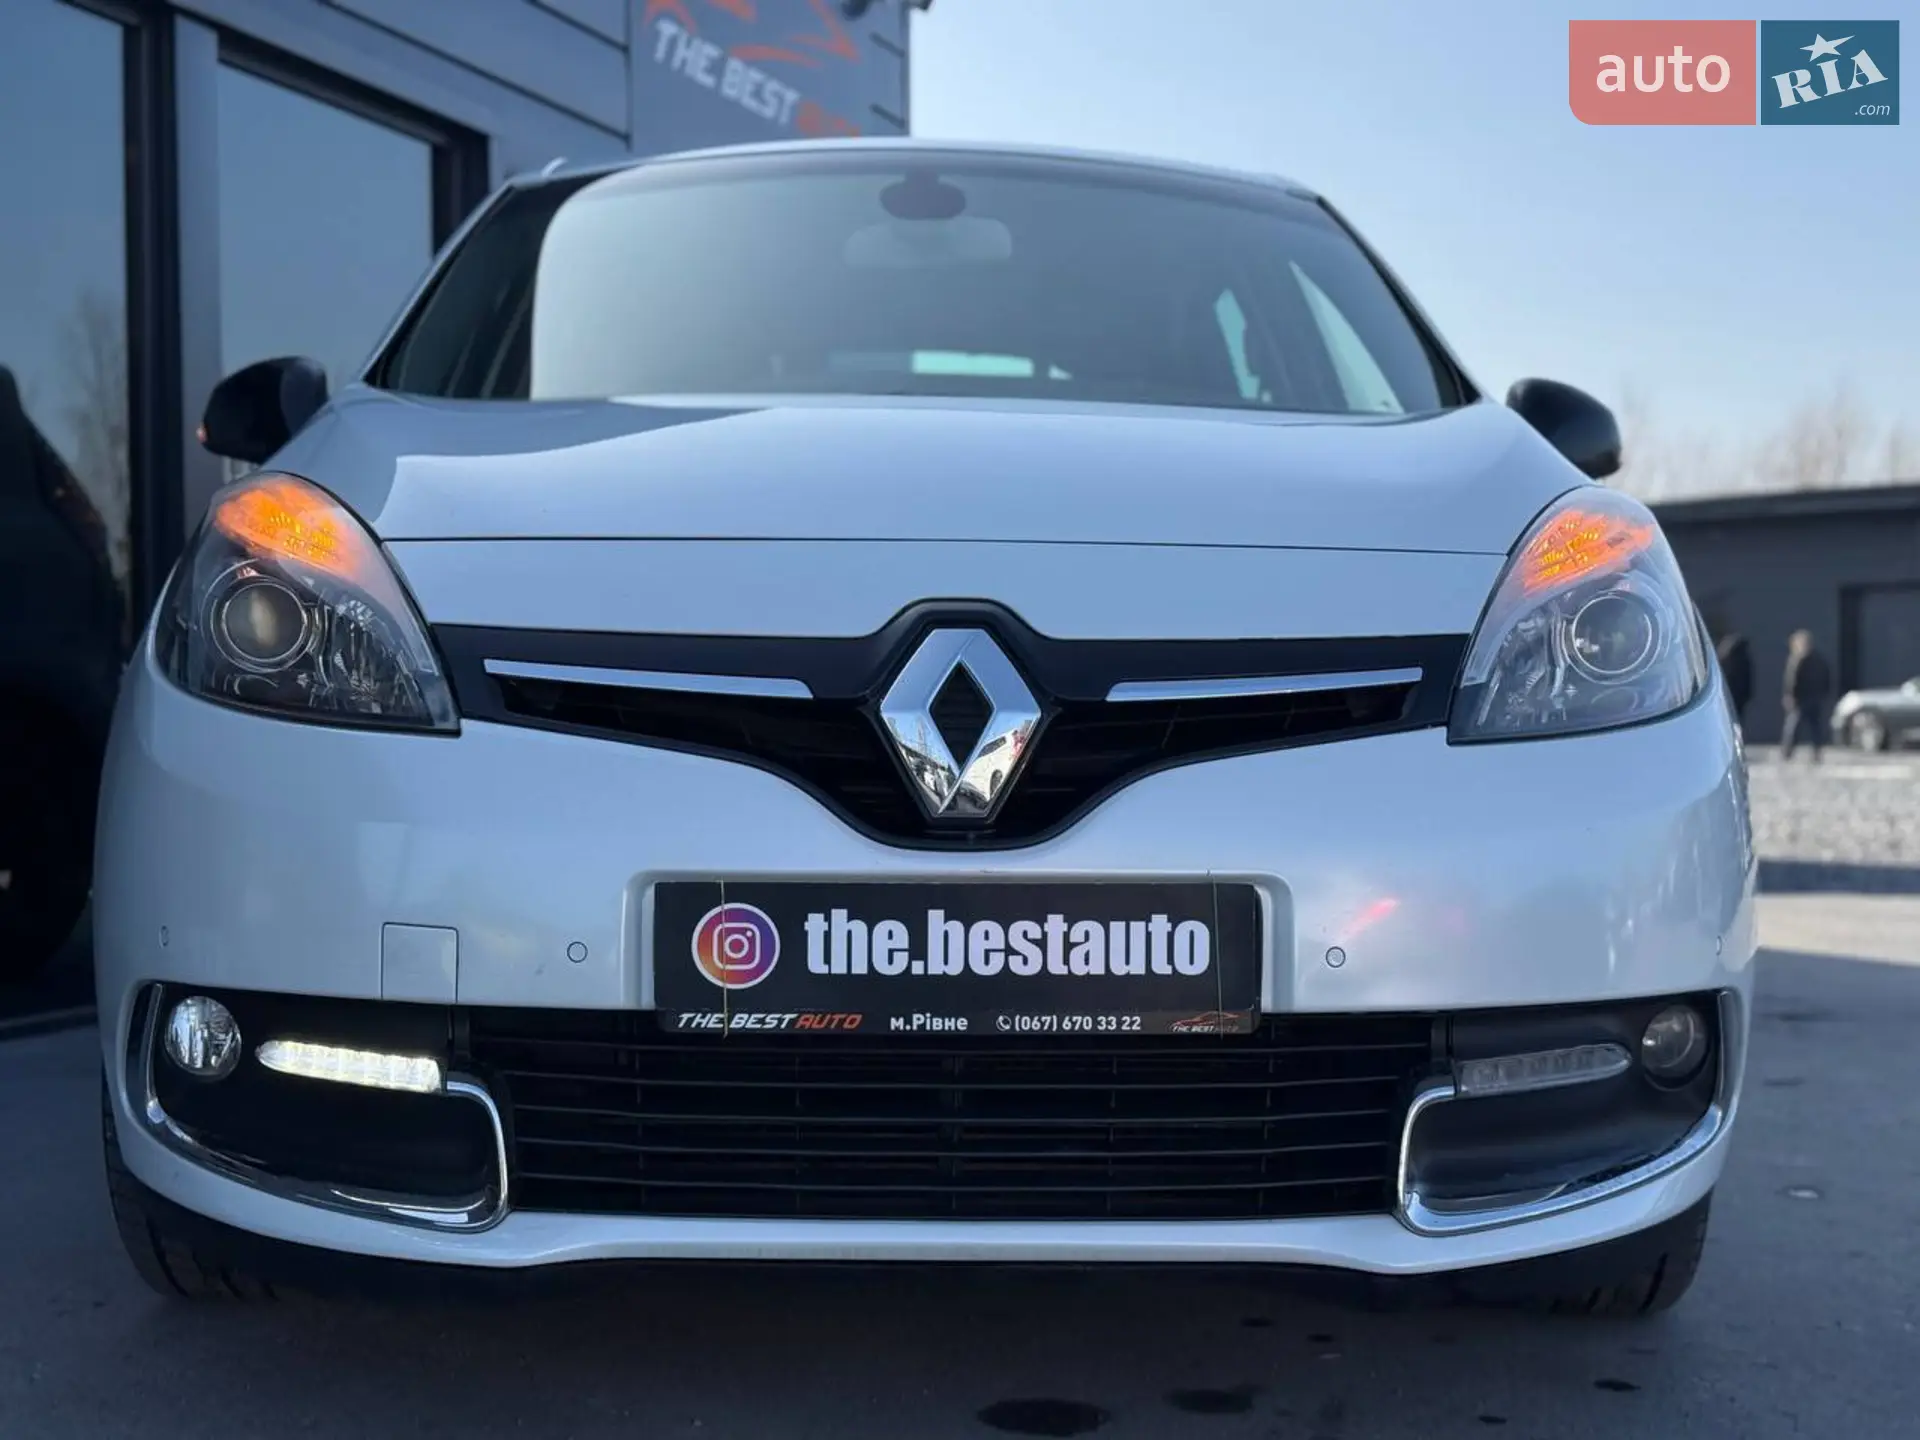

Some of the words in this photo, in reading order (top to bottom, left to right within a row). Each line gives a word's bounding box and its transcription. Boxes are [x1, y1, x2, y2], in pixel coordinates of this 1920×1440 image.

[653, 17, 724, 90] THE
[720, 56, 801, 125] BEST
[804, 908, 1211, 977] the.bestauto
[677, 1012, 725, 1030] THE
[728, 1012, 799, 1030] BEST
[794, 1013, 863, 1030] AUTO
[1014, 1014, 1057, 1033] (067)
[1062, 1015, 1093, 1031] 670
[1096, 1015, 1117, 1031] 33
[1120, 1015, 1142, 1031] 22
